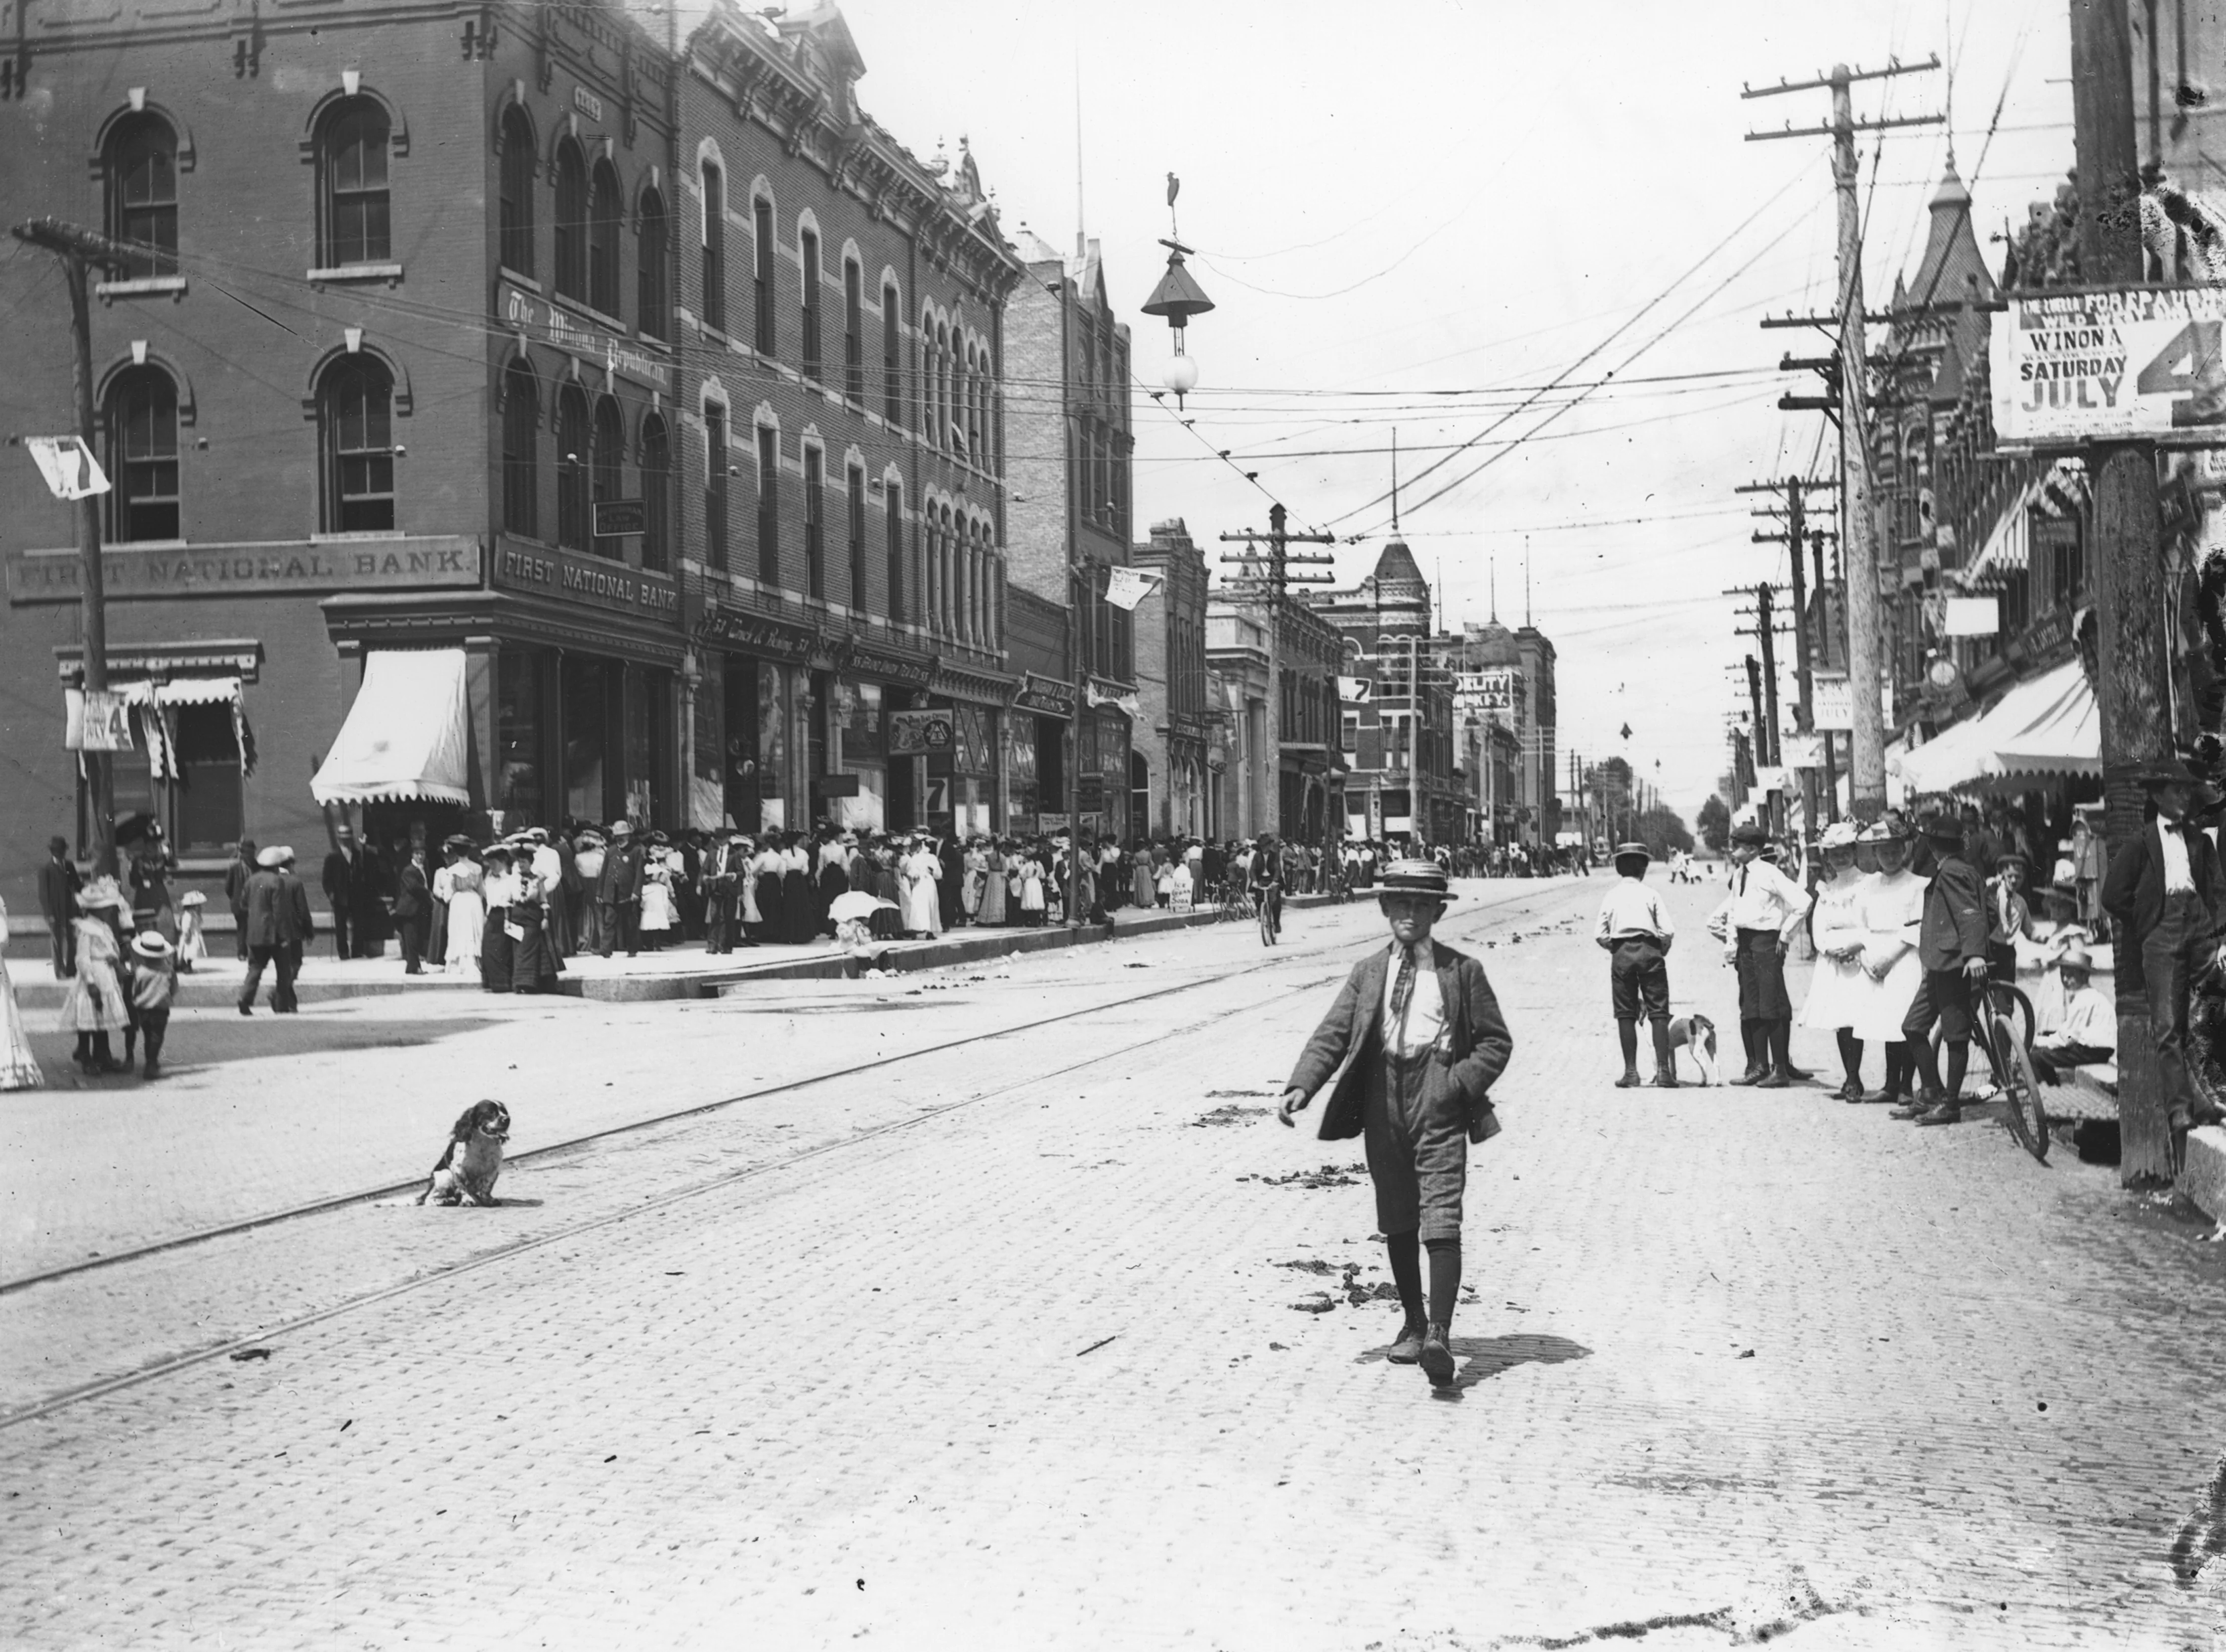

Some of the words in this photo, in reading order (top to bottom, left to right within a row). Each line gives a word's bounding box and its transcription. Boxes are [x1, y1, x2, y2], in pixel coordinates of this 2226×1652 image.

[508, 290, 535, 326] The
[547, 305, 596, 353] Winona
[2041, 313, 2087, 329] WILD
[2030, 328, 2122, 352] WINONA
[2020, 355, 2128, 381] SATURDAY
[2137, 321, 2226, 428] 4
[2021, 376, 2123, 413] JULY
[21, 562, 125, 585] FIRT
[148, 556, 332, 582] NATIONAL
[504, 550, 554, 582] FIRST
[563, 566, 633, 601] NATIONAL
[640, 584, 676, 611] BANK
[1355, 679, 1370, 701] 7
[1456, 676, 1507, 692] DELITY
[109, 707, 134, 750] 4
[927, 779, 946, 811] 7
